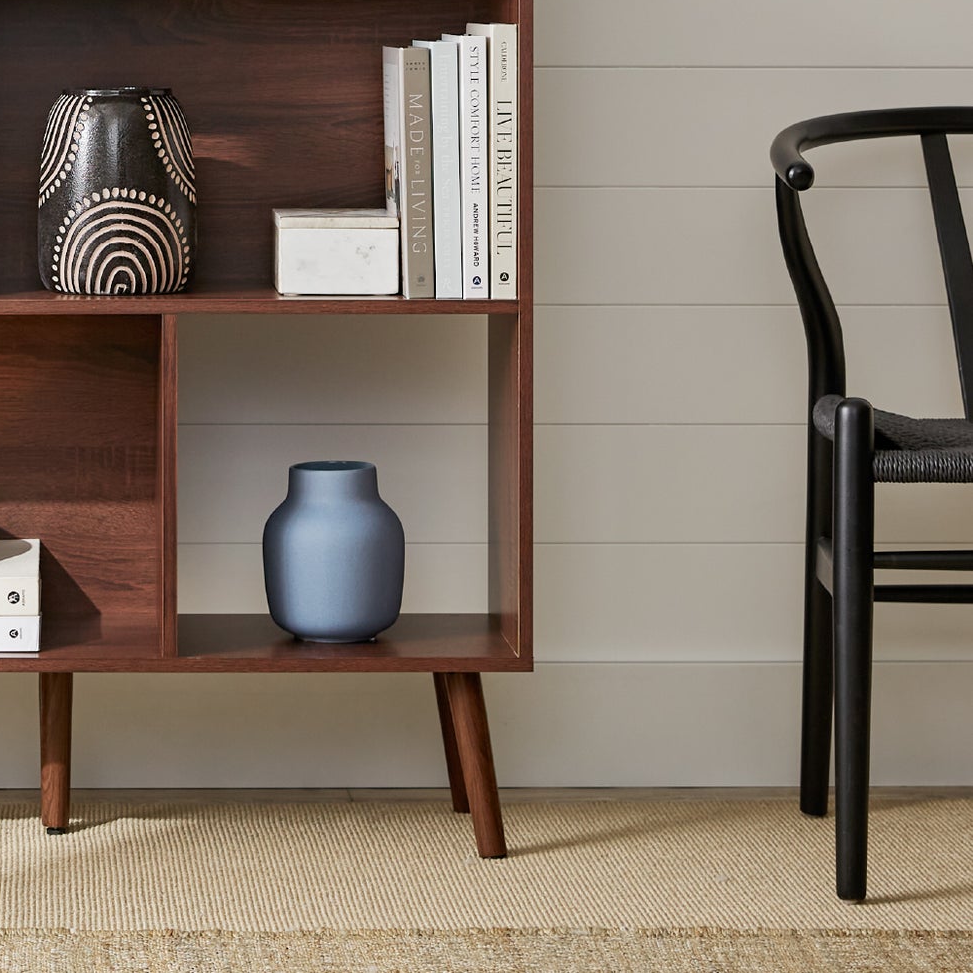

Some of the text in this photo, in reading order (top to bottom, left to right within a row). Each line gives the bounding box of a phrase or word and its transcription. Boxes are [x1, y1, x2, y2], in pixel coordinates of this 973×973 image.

[409, 93, 424, 156] MADE
[470, 46, 480, 193] STYLE COMFORT HOME
[411, 179, 427, 253] LIVING
[497, 101, 512, 255] LIVE BEAUTIFUL
